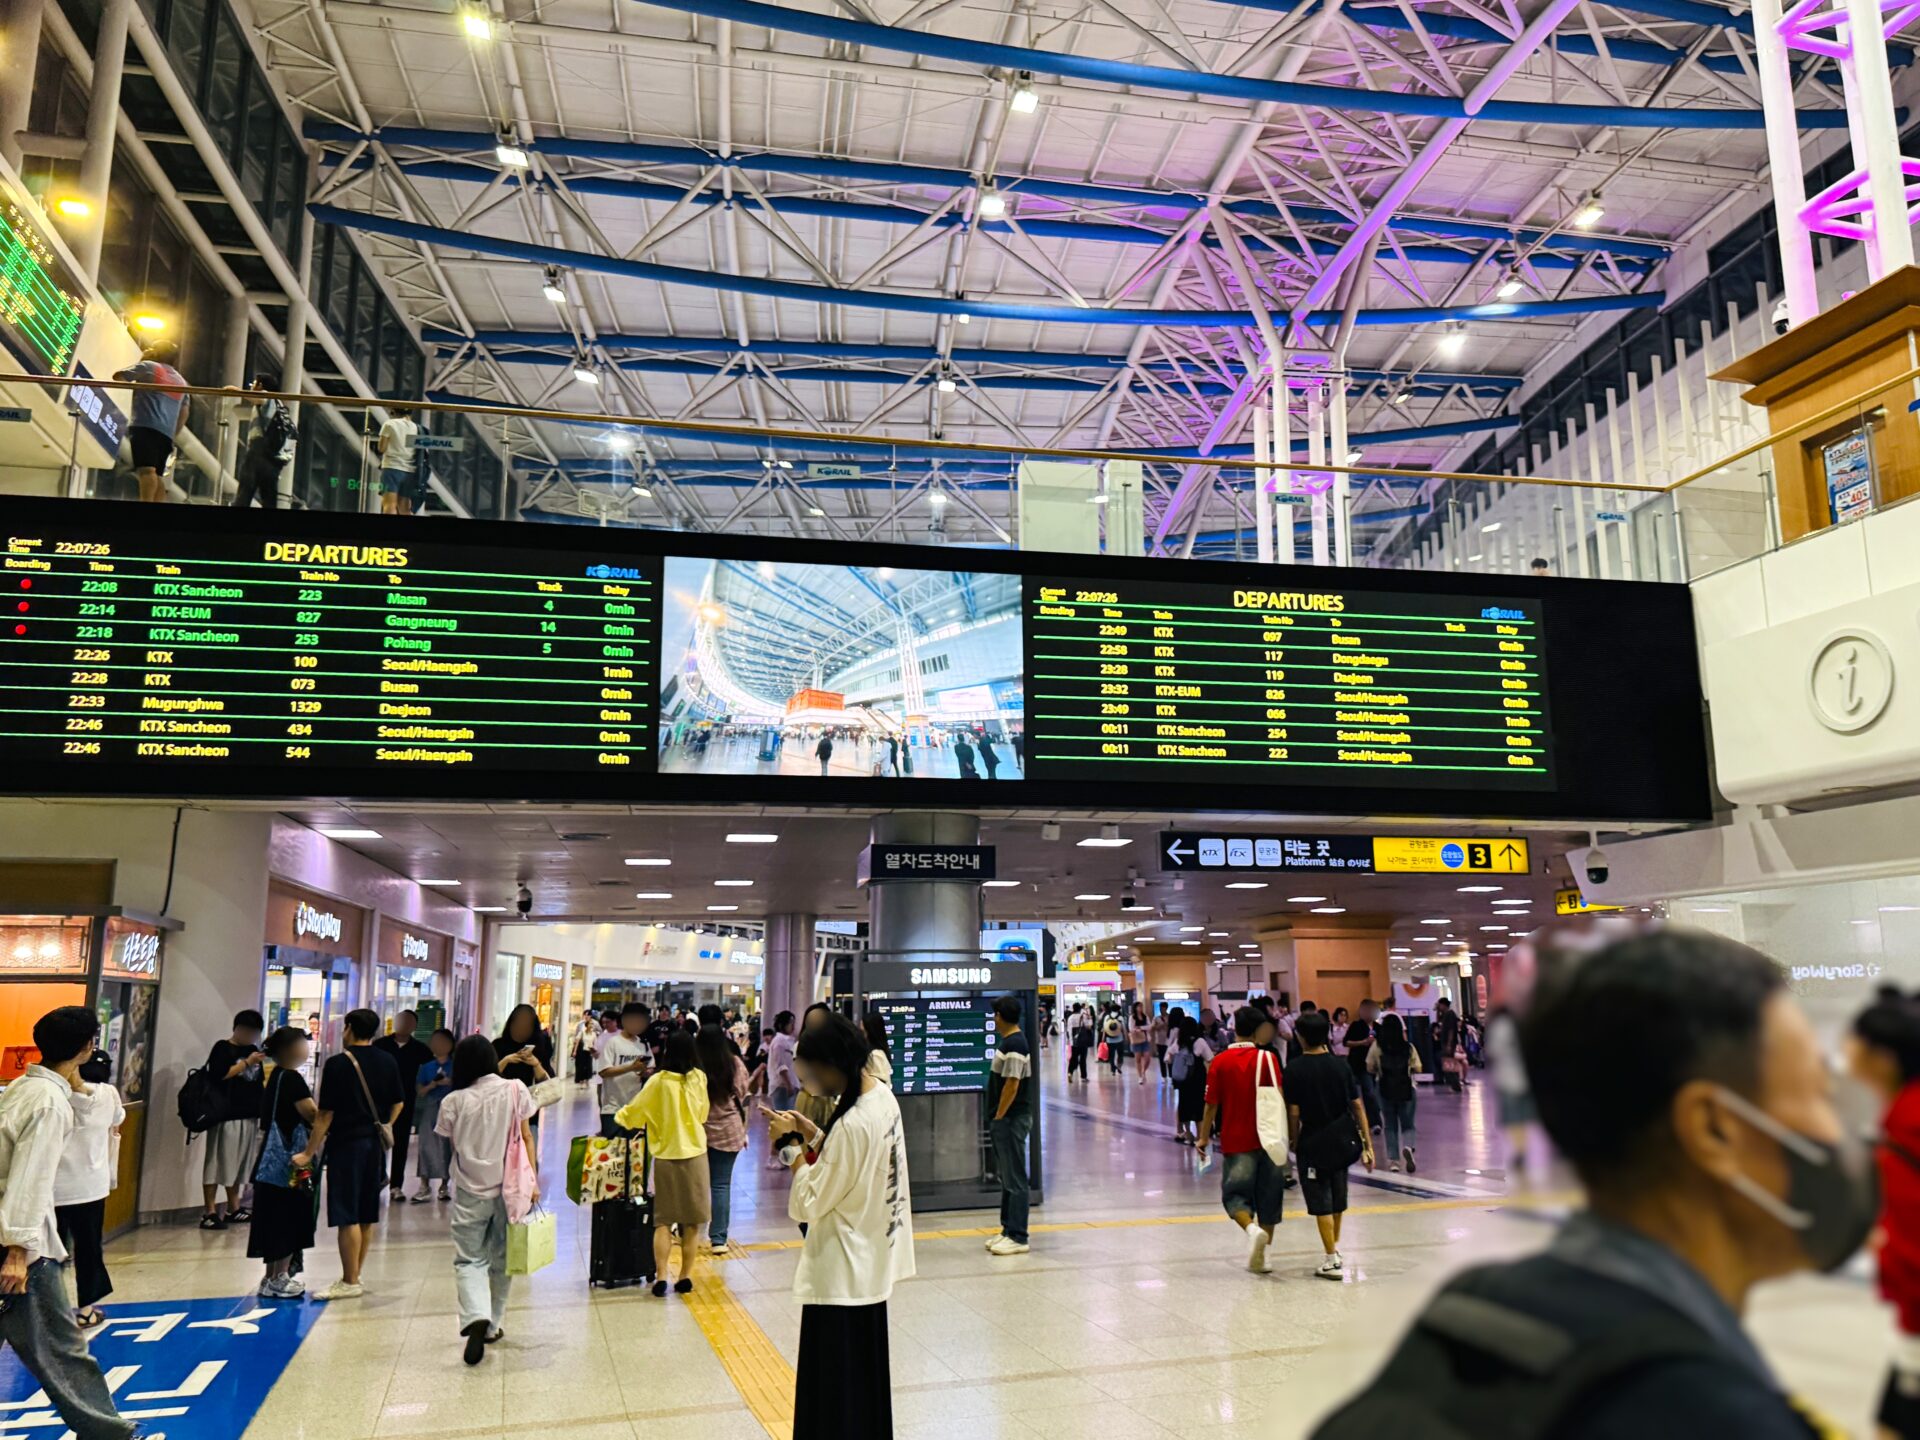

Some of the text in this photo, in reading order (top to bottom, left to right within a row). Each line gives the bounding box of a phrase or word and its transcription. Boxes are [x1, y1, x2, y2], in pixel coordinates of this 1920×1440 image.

[415, 437, 454, 448] KORAIL
[817, 466, 852, 476] KORAIL
[1275, 495, 1306, 503] KORAIL
[8, 537, 42, 547] Current
[8, 545, 30, 554] Time
[55, 542, 110, 556] 22:07:26
[264, 542, 408, 567] DEPARTURES
[5, 558, 51, 571] Boarding
[89, 562, 114, 573] Time
[156, 565, 181, 575] Train
[300, 571, 340, 582] Train No
[586, 564, 641, 579] KORAIL
[388, 574, 402, 584] To
[81, 581, 118, 594] 22:08
[154, 584, 243, 598] KTX Sancheon
[537, 581, 562, 592] Track
[603, 584, 630, 597] Delay
[1040, 587, 1066, 596] Current
[298, 590, 323, 602] 223
[387, 592, 427, 606] Masan
[1076, 591, 1118, 603] 22:07:26
[1233, 590, 1345, 612] DEPARTURES
[79, 603, 116, 616] 22:14
[543, 600, 554, 612] 4
[604, 603, 635, 615] 0min
[1040, 606, 1075, 617] Boarding
[151, 606, 211, 619] KTX-EUM
[296, 612, 321, 624] 827
[1103, 608, 1122, 618] Time
[1153, 610, 1173, 620] Train
[1481, 606, 1526, 620] KORAIL
[385, 614, 458, 631] Gangneung
[540, 621, 556, 633] 14
[1330, 618, 1342, 627] To
[76, 626, 113, 639] 22:18
[149, 629, 239, 644] KTX Sancheon
[603, 624, 634, 637] 0min
[1100, 625, 1127, 636] 22:49
[1153, 627, 1174, 638] KTX
[295, 634, 319, 646] 253
[384, 636, 432, 652] Pohang
[1331, 634, 1360, 645] Busan
[542, 643, 552, 654] 5
[603, 645, 633, 658] 0min
[1100, 645, 1128, 655] 22:58
[1154, 646, 1174, 657] KTX
[74, 649, 110, 662] 22:26
[147, 651, 173, 663] KTX
[1265, 651, 1283, 662] 117
[1332, 653, 1389, 667] Dongdaegu
[294, 656, 318, 668] 100
[382, 659, 478, 675] Seoul/Haengsin
[603, 666, 633, 679] 1min
[1100, 664, 1128, 675] 23:28
[1155, 666, 1175, 677] KTX
[1265, 670, 1284, 681] 119
[71, 672, 108, 684] 22:28
[144, 674, 171, 686] KTX
[1333, 672, 1374, 685] Daejeon
[291, 679, 315, 690] 073
[380, 681, 419, 694] Busan
[1101, 684, 1129, 695] 23:32
[601, 687, 632, 700] 0min
[1156, 686, 1201, 697] KTX-EUM
[68, 695, 105, 708] 22:33
[143, 697, 224, 712] Mugunghwa
[1334, 691, 1408, 706] Seoul/Haengsin
[290, 701, 321, 713] 1329
[379, 703, 431, 718] Daejeon
[1101, 704, 1129, 715] 23:49
[1156, 705, 1176, 716] KTX
[600, 709, 631, 722] 0min
[1335, 711, 1409, 725] Seoul/Haengsin
[66, 719, 103, 731] 22:46
[140, 720, 231, 734] KTX Sancheon
[287, 724, 312, 736] 434
[1102, 724, 1128, 734] 00:11
[377, 725, 474, 741] Seoul/Haengsin
[599, 731, 630, 743] 0min
[1157, 725, 1226, 738] KTX Sancheon
[1268, 728, 1287, 739] 254
[1337, 730, 1411, 744] Seoul/Haengsin
[63, 743, 100, 754] 22:46
[137, 744, 229, 757] KTX Sancheon
[285, 747, 310, 758] 544
[1102, 744, 1129, 754] 00:11
[1157, 745, 1226, 758] KTX Sancheon
[1269, 748, 1288, 759] 222
[376, 747, 472, 764] Seoul/Haengsin
[598, 752, 629, 765] 0min
[1338, 750, 1412, 764] Seoul/Haengsin
[1202, 849, 1219, 857] KTX
[1284, 840, 1330, 856] 타는 곳
[885, 853, 980, 870] 열차도착안내
[1285, 857, 1326, 867] Platforms
[1474, 847, 1487, 866] 3
[911, 968, 991, 984] SAMSUNG
[929, 1001, 971, 1010] ARRIVALS
